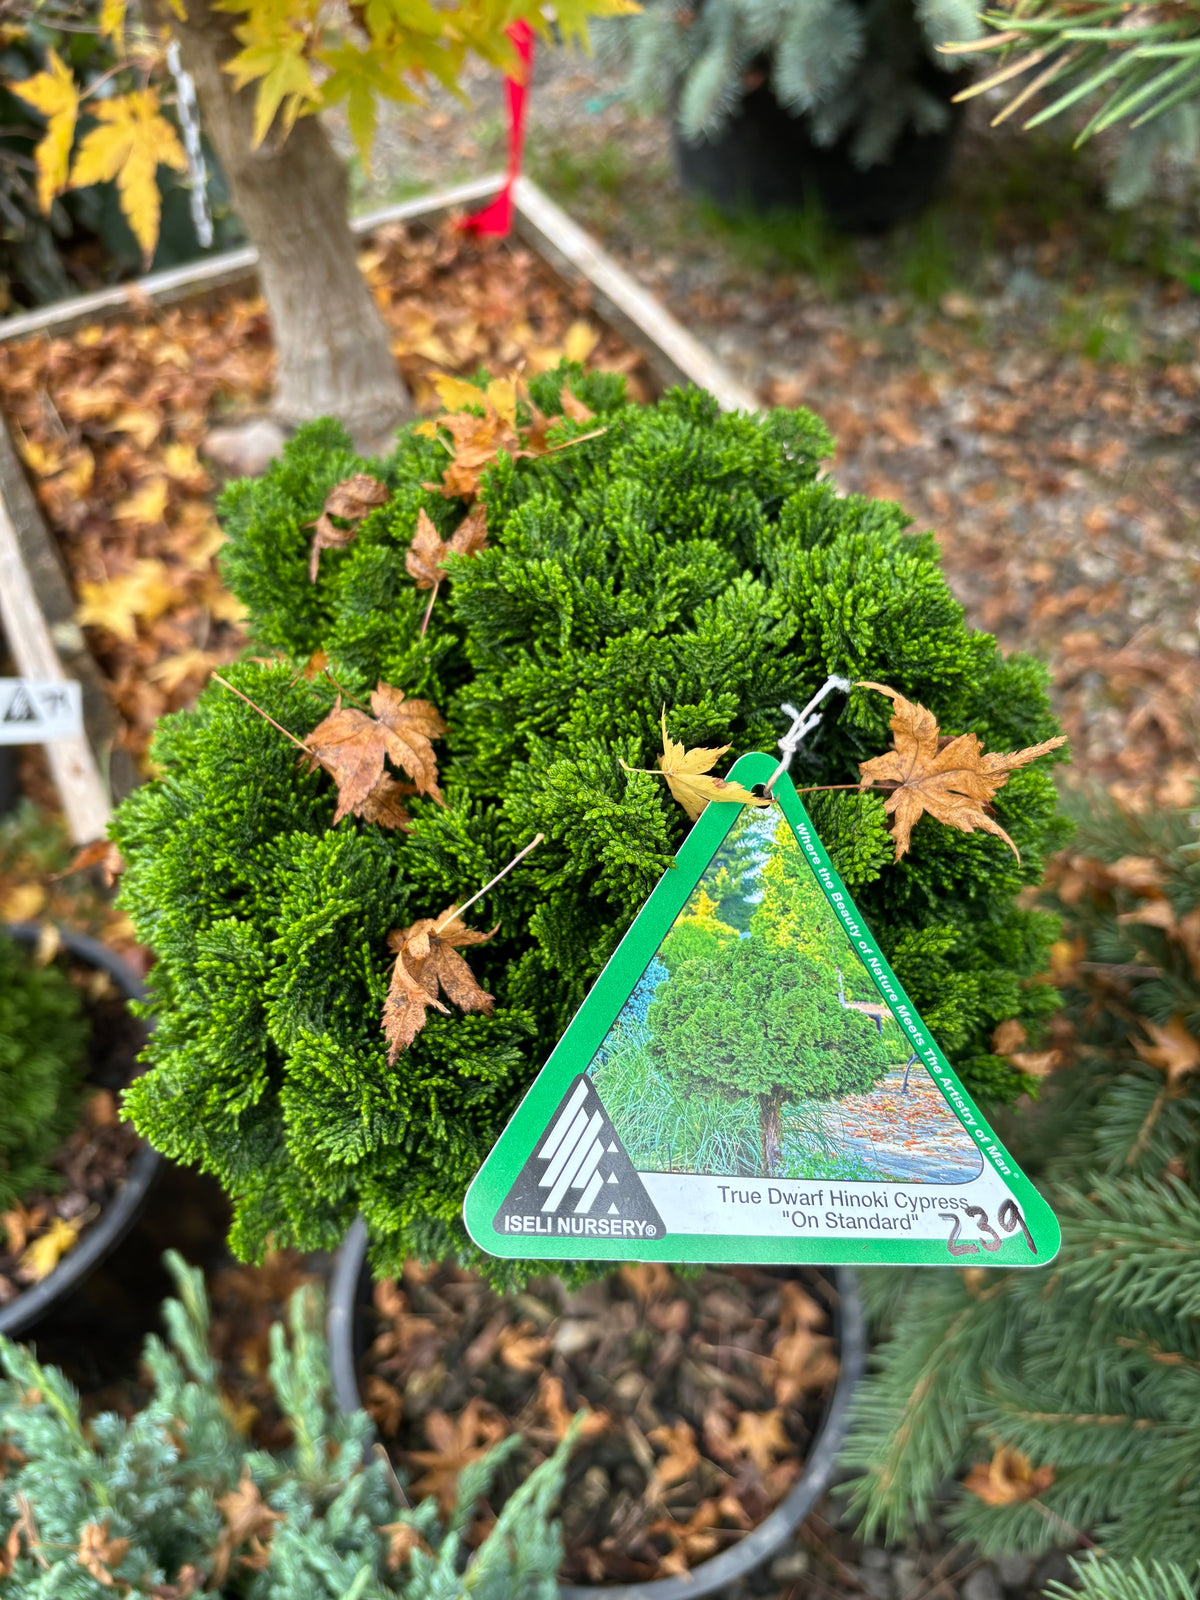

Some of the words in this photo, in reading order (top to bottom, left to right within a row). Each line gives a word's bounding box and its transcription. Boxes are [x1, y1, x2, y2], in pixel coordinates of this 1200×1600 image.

[796, 822, 821, 865] Where
[818, 867, 834, 889] the
[831, 892, 862, 938] Beauty
[858, 941, 873, 955] of
[868, 957, 898, 1002] Nature
[896, 1005, 925, 1046] Meets
[923, 1048, 942, 1074] The
[940, 1077, 978, 1126] Artistry
[975, 1129, 991, 1143] of
[717, 1185, 762, 1204] True
[768, 1187, 823, 1206] Dwarf
[829, 1190, 889, 1208] Hinoki
[894, 1192, 969, 1213] Cypress
[505, 1215, 552, 1233] ISELI
[782, 1210, 819, 1228] "On
[825, 1211, 919, 1230] Standard"
[938, 1198, 1038, 1257] 239
